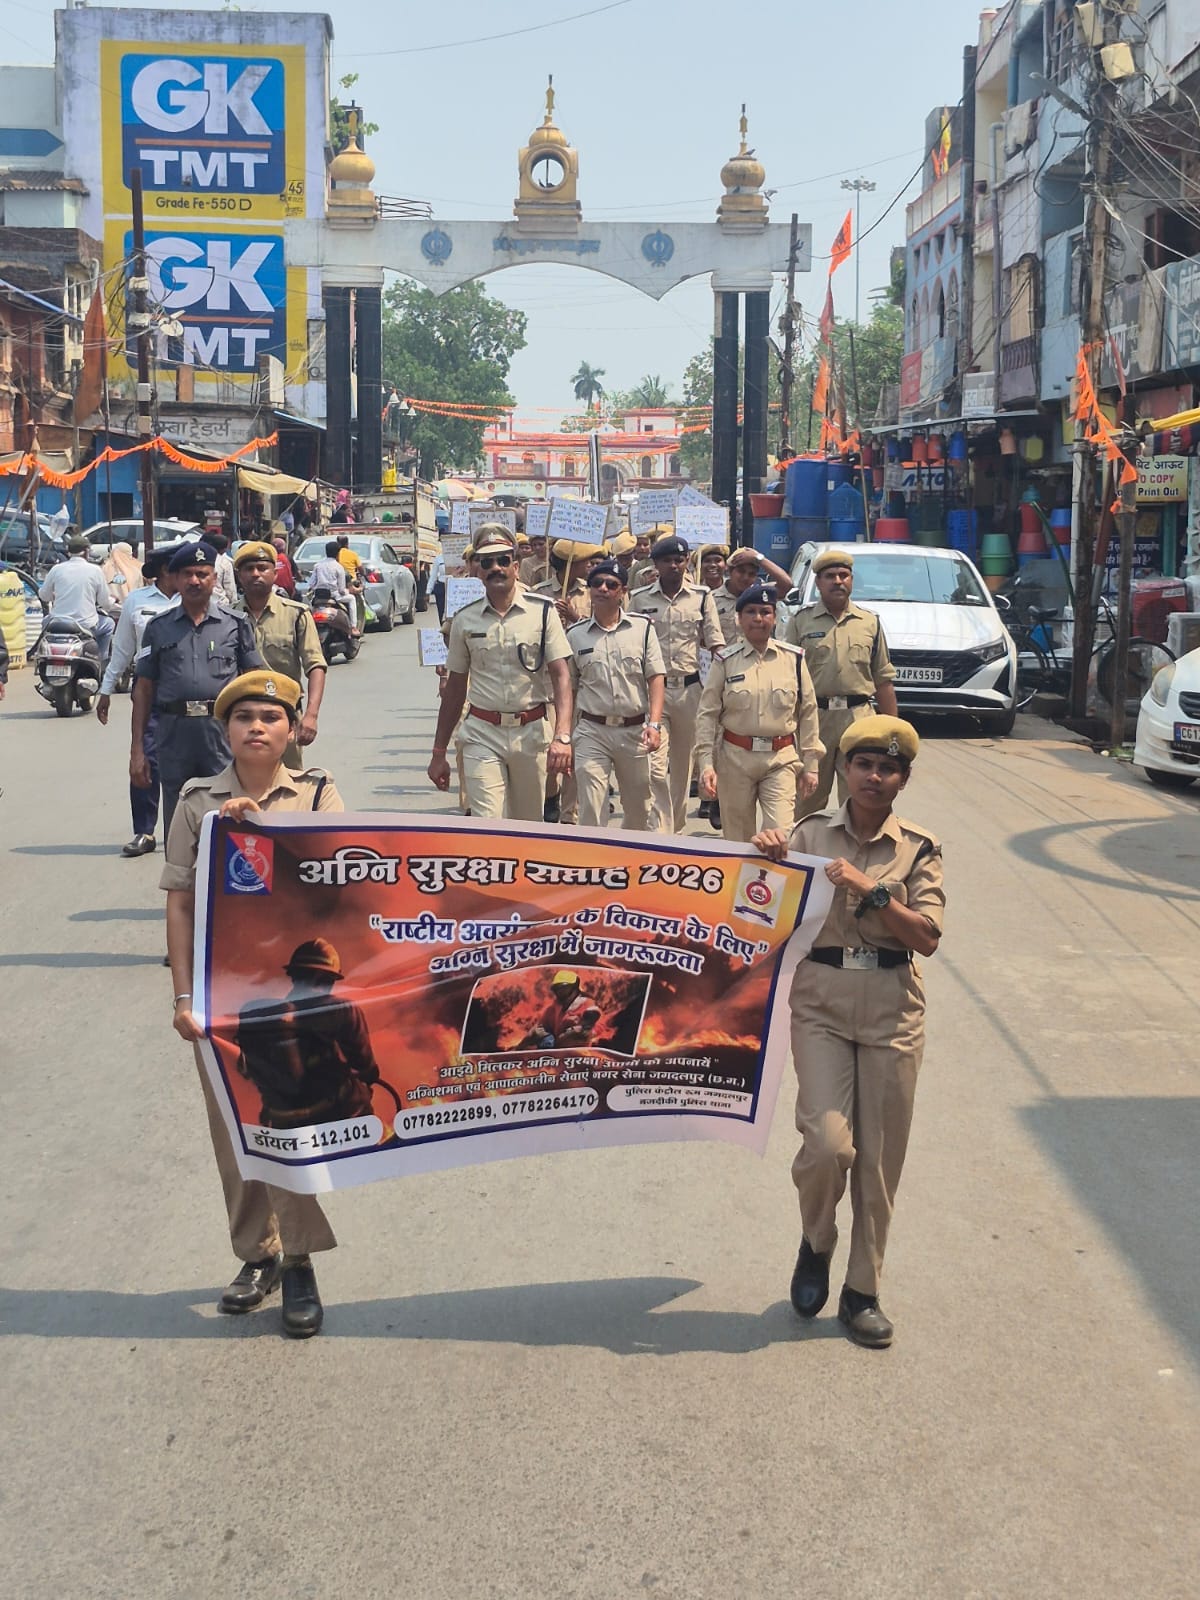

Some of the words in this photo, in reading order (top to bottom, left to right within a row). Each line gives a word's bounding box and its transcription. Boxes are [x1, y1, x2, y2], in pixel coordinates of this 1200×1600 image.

[132, 59, 274, 136] GK
[139, 150, 269, 188] TMT
[156, 197, 190, 208] Grade
[193, 198, 236, 210] Fe-550
[239, 198, 253, 211] D
[144, 237, 276, 313] GK
[1138, 487, 1160, 496] Print
[1163, 487, 1179, 496] Out
[1150, 475, 1175, 484] COPY
[299, 847, 400, 886] अग्नि
[408, 856, 517, 893] सुरक्षा
[640, 863, 723, 893] 2026
[605, 904, 681, 935] विकास
[686, 916, 710, 941] के
[431, 947, 489, 971] अग्नि
[494, 938, 556, 969] सुरक्षा
[560, 930, 582, 953] में
[585, 938, 703, 973] जागरूकता
[478, 1060, 522, 1074] मिलकर
[527, 1056, 560, 1069] अग्नि
[564, 1056, 599, 1069] सुरक्षा
[407, 1084, 463, 1101] अग्निशमन
[466, 1079, 481, 1093] एवं
[485, 1071, 556, 1090] आपातकालीन
[560, 1068, 589, 1082] सेवाएं
[592, 1070, 619, 1079] नगर
[622, 1068, 647, 1079] सेना
[649, 1070, 705, 1084] जगदलपुर
[625, 1086, 652, 1097] पुलिस
[403, 1105, 497, 1131] 07782222899,
[502, 1094, 595, 1116] 07782264170
